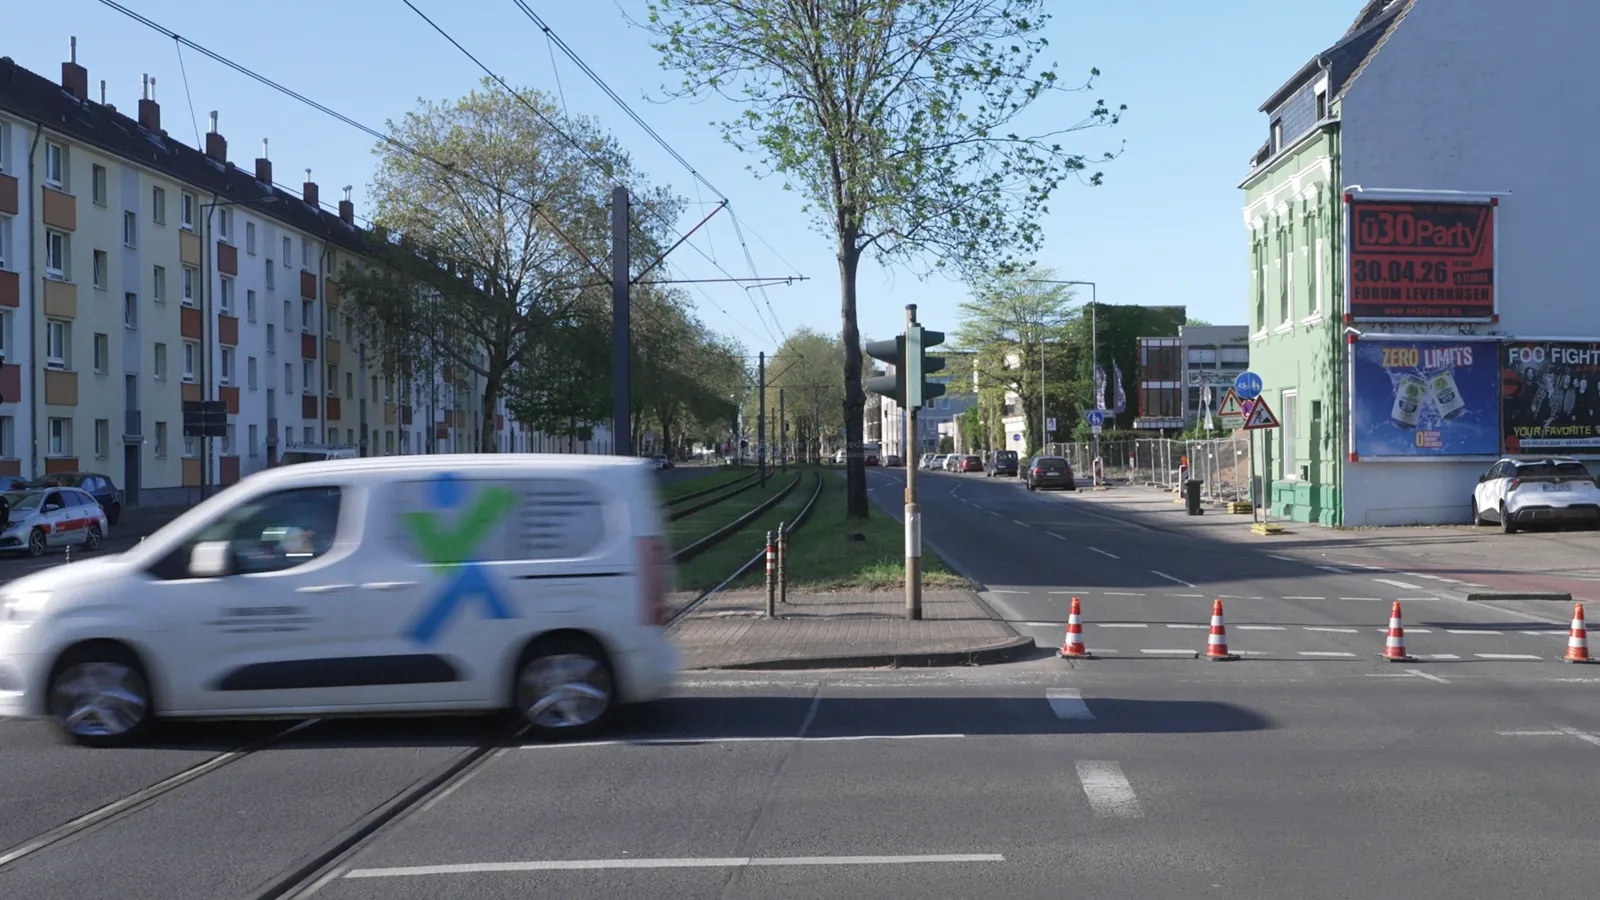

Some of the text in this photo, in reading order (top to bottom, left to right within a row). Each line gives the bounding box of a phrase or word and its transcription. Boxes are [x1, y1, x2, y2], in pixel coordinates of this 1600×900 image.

[1354, 260, 1447, 283] 30.04.26
[1354, 286, 1489, 301] FORUM LEVERKUSEN
[1381, 346, 1473, 368] ZERO LIMITS
[1509, 346, 1600, 365] FOO FIGHT
[1513, 426, 1541, 437] YOUR
[1544, 425, 1592, 436] FAVORITE
